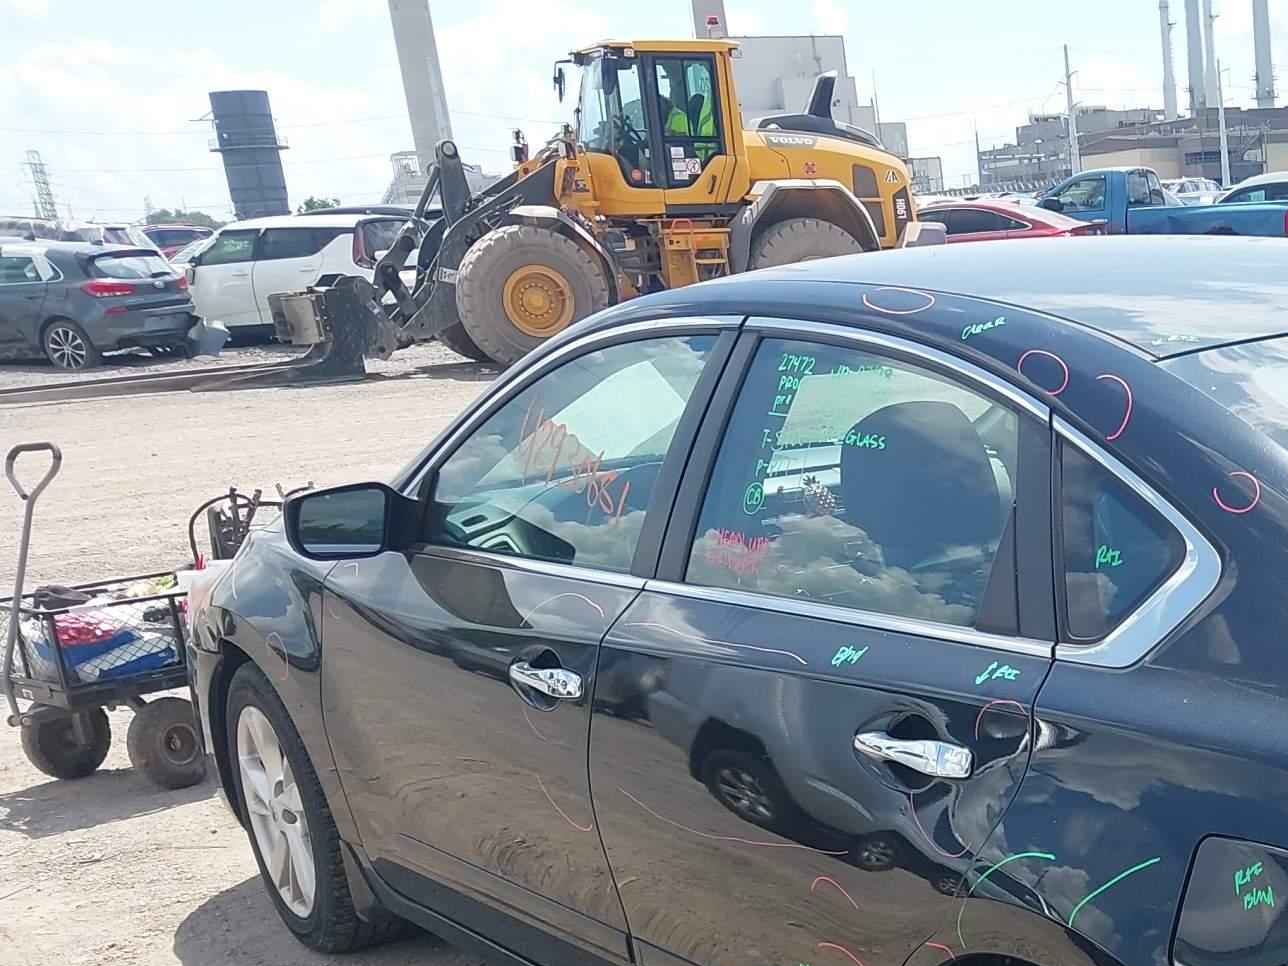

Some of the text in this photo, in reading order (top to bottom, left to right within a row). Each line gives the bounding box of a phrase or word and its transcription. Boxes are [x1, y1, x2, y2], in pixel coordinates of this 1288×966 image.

[769, 136, 813, 145] VOLVO
[896, 199, 907, 219] L90H
[778, 353, 816, 375] 27472
[845, 430, 886, 450] GLASS
